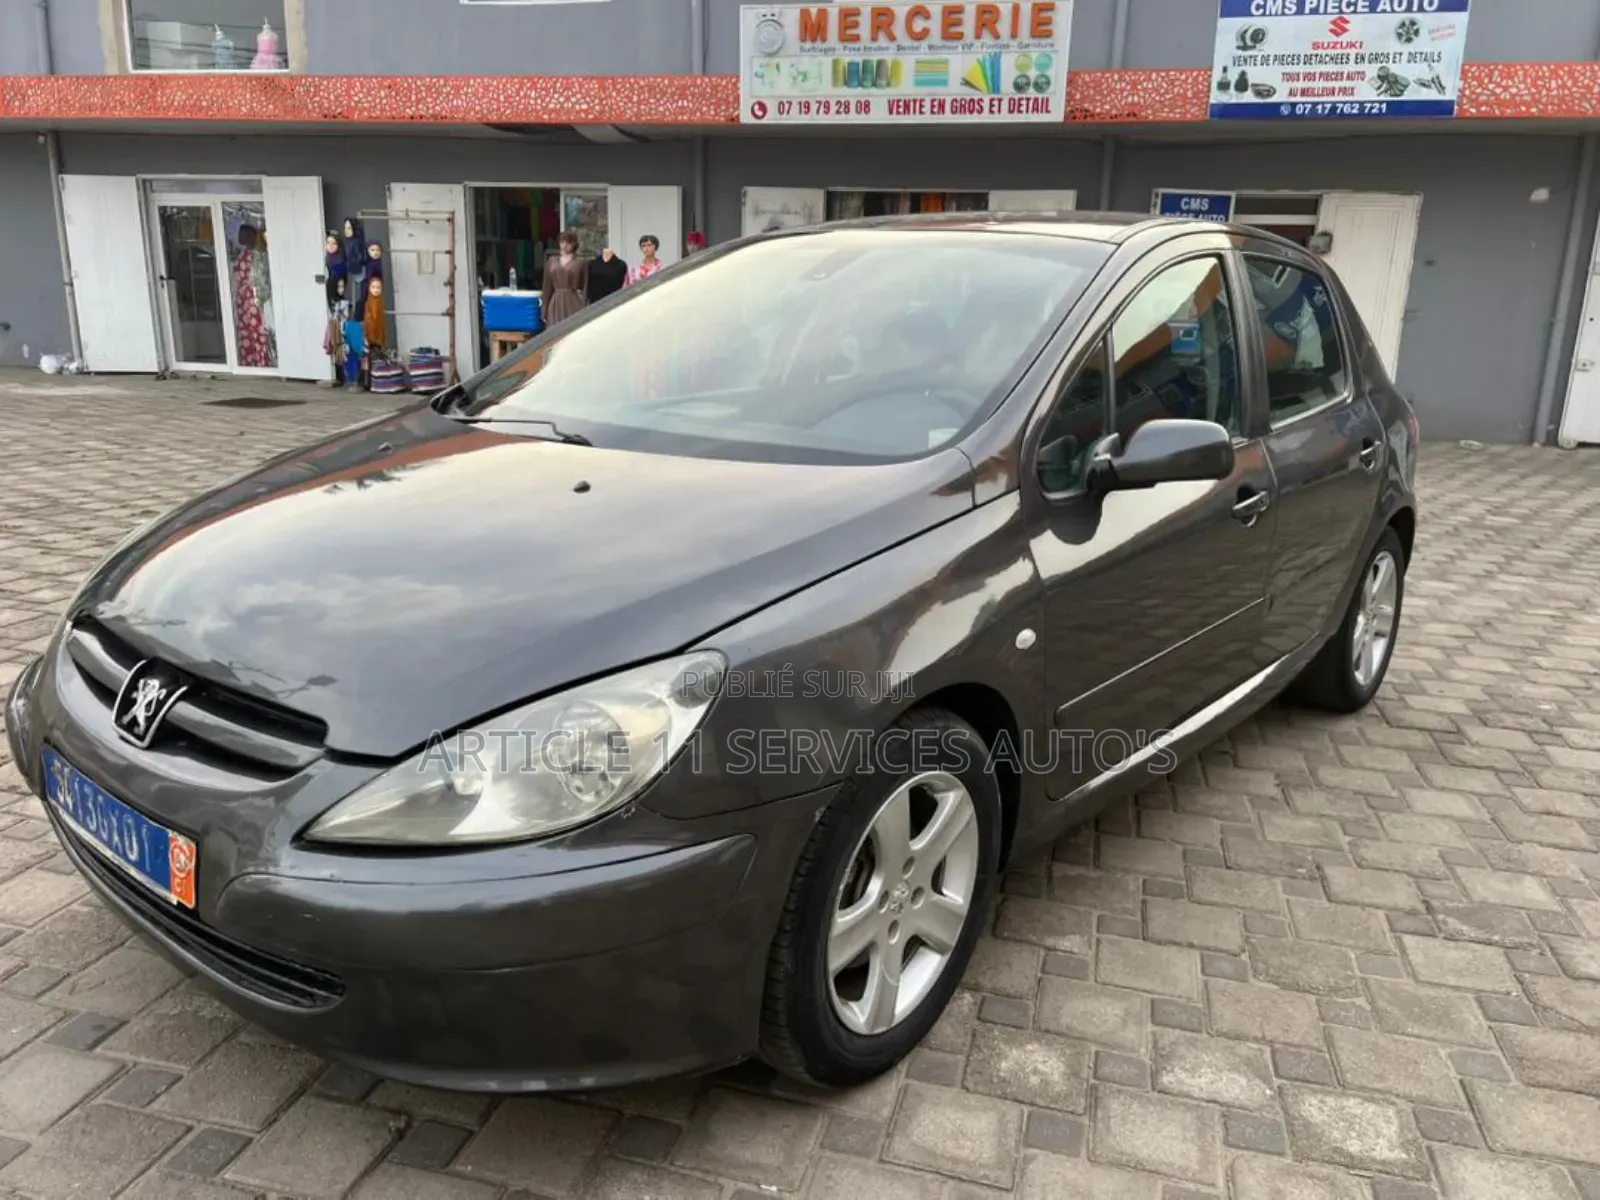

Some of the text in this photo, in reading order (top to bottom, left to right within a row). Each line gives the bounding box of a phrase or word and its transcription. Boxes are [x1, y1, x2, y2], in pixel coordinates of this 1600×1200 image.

[1250, 0, 1297, 15] CMS
[1375, 0, 1439, 12] AUTO
[800, 3, 1055, 42] MERCERIE
[1311, 41, 1364, 50] SUZUKI
[1232, 51, 1442, 66] VENTE DE PIECES DETACHEES EN GROS ET DETAILS
[1281, 70, 1366, 82] TOUS VOS PIECES AUTO
[1288, 86, 1355, 97] AU MEILLEUR PRIX
[777, 96, 1052, 115] 07 19 79 28 08 VENTE EN GROS ET DETAIL
[1296, 103, 1387, 114] 07 17 762 721
[1180, 196, 1210, 211] CMS
